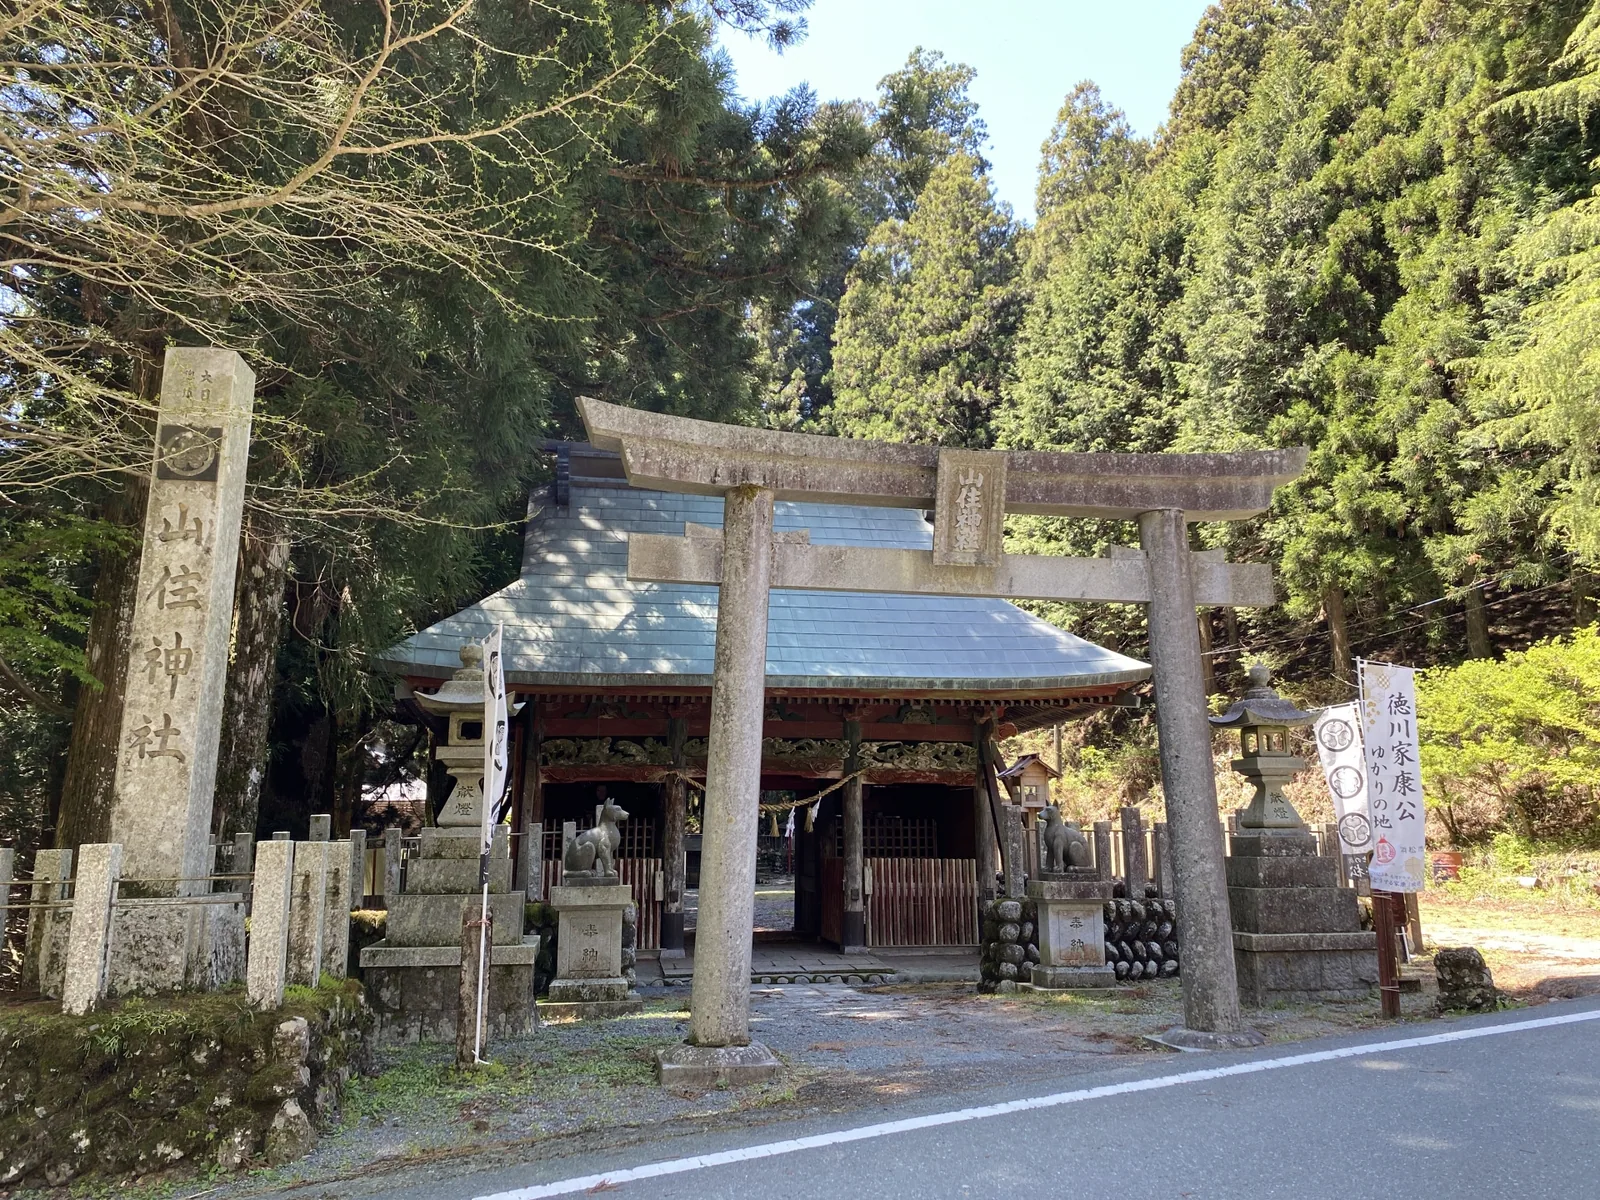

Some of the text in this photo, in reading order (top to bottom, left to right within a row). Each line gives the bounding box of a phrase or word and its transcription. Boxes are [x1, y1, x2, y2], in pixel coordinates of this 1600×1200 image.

[954, 467, 984, 552] 山住神社
[128, 502, 203, 763] 山住神社
[1370, 745, 1393, 829] ゆかりの地
[1387, 691, 1416, 821] 徳川家康公
